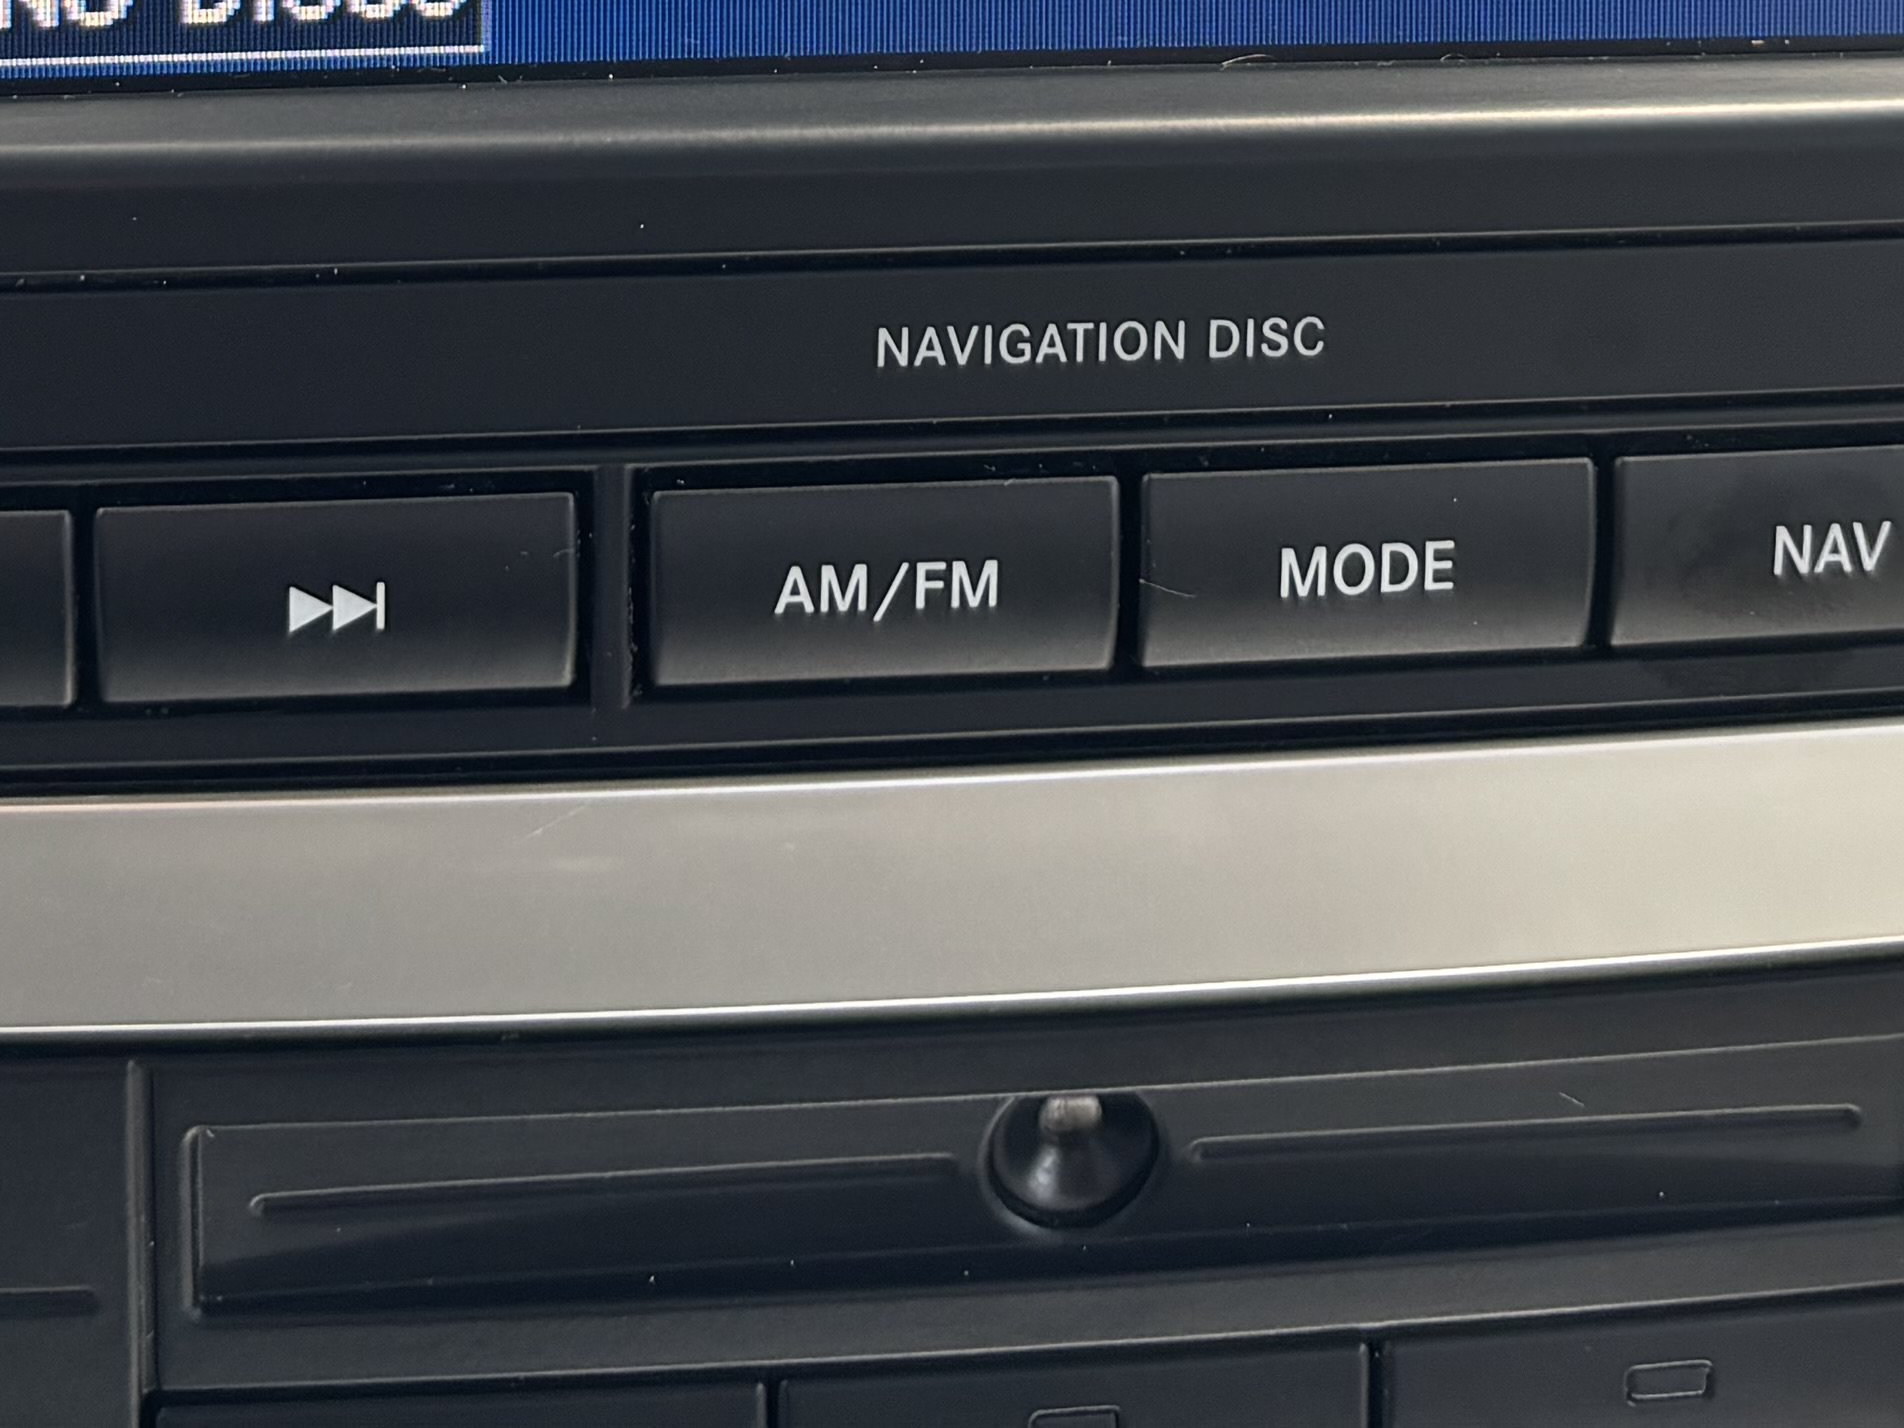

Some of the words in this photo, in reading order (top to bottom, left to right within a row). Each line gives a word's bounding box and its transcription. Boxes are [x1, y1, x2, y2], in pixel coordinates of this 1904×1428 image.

[876, 318, 1187, 369] NAVIGATION
[1207, 316, 1327, 360] DISC
[1279, 540, 1456, 600] MODE
[1772, 520, 1892, 578] NAV
[774, 559, 1000, 623] AM/FM
